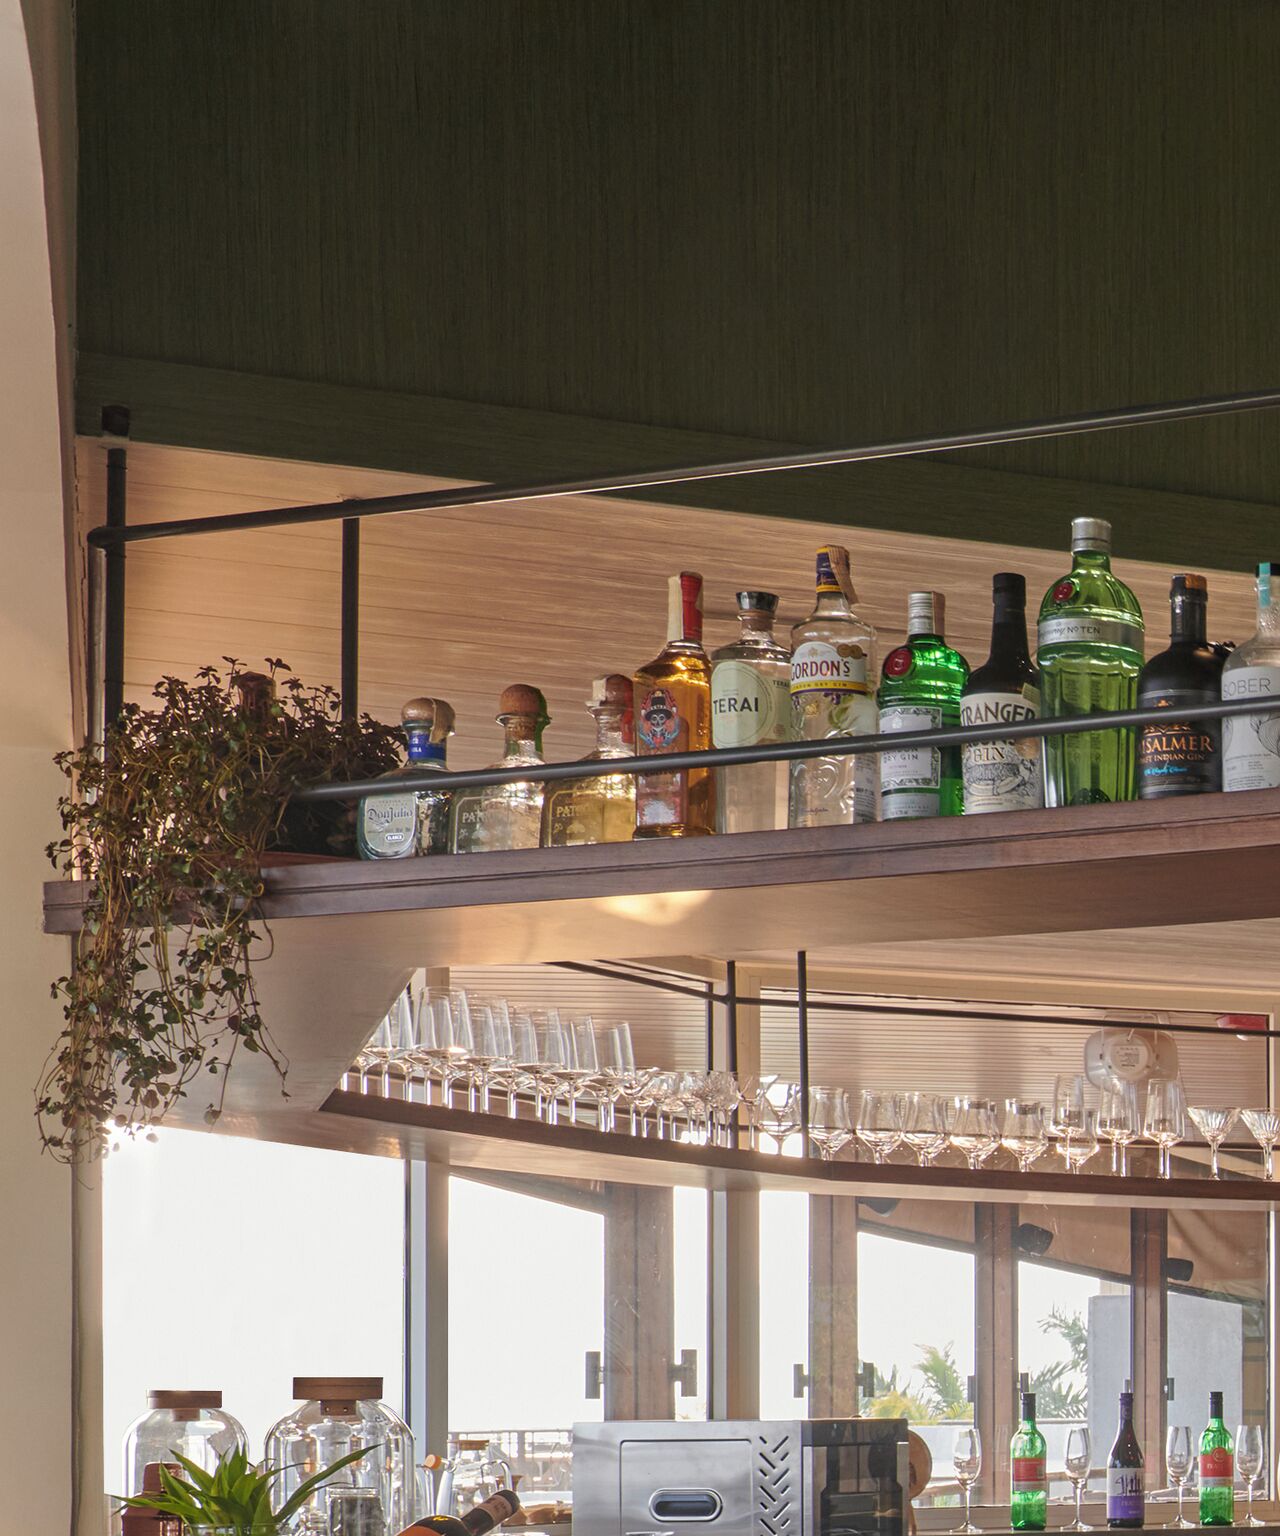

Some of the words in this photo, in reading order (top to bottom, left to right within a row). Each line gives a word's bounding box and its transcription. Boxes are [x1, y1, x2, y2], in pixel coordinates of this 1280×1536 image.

[1080, 626, 1101, 634] TEN
[1223, 677, 1272, 699] SOBER
[713, 696, 760, 716] TERAI
[901, 753, 919, 761] GIN
[972, 747, 1006, 762] GIN
[1154, 753, 1185, 762] INDIAN
